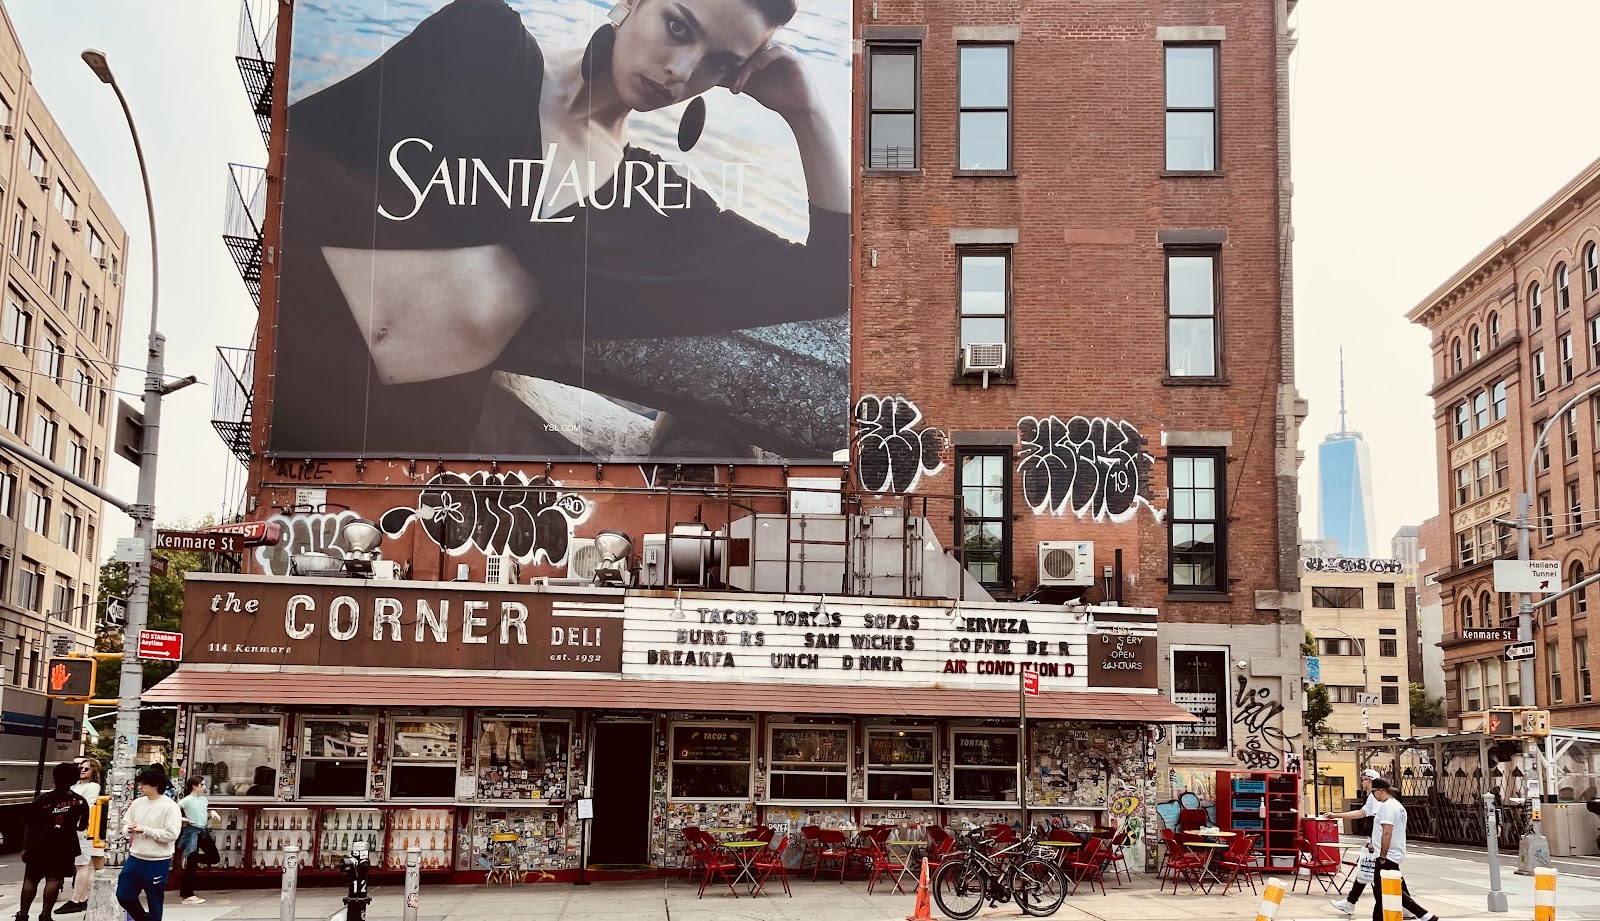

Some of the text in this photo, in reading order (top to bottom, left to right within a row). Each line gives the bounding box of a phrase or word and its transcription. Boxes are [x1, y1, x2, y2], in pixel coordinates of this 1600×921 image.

[543, 423, 581, 432] YSL.COM
[157, 533, 235, 551] Kenmare St
[1529, 561, 1559, 569] Holland
[1532, 570, 1557, 578] Tunnel
[210, 591, 260, 613] the
[112, 604, 124, 619] ONE
[285, 594, 529, 645] CORNER
[697, 607, 759, 625] TACOS
[863, 612, 920, 631] SOPAS
[957, 616, 1030, 634] ERVEZA
[150, 633, 177, 642] STANDING
[551, 626, 602, 647] DELI
[1463, 630, 1512, 640] Kenmare St
[141, 639, 164, 647] Anytime
[208, 643, 292, 653] 114 Kenmare
[949, 637, 1011, 654] COFFEE
[1111, 650, 1135, 659] OPEN
[1508, 646, 1532, 656] ONE WAY
[550, 653, 602, 663] est. 1932
[647, 650, 736, 668] BREAKFA
[770, 652, 819, 669] UNCH
[943, 659, 968, 674] AIR
[703, 732, 728, 741] TACOS
[960, 738, 990, 747] TORTAS
[880, 753, 927, 763] ROIZADO
[353, 879, 367, 894] 12
